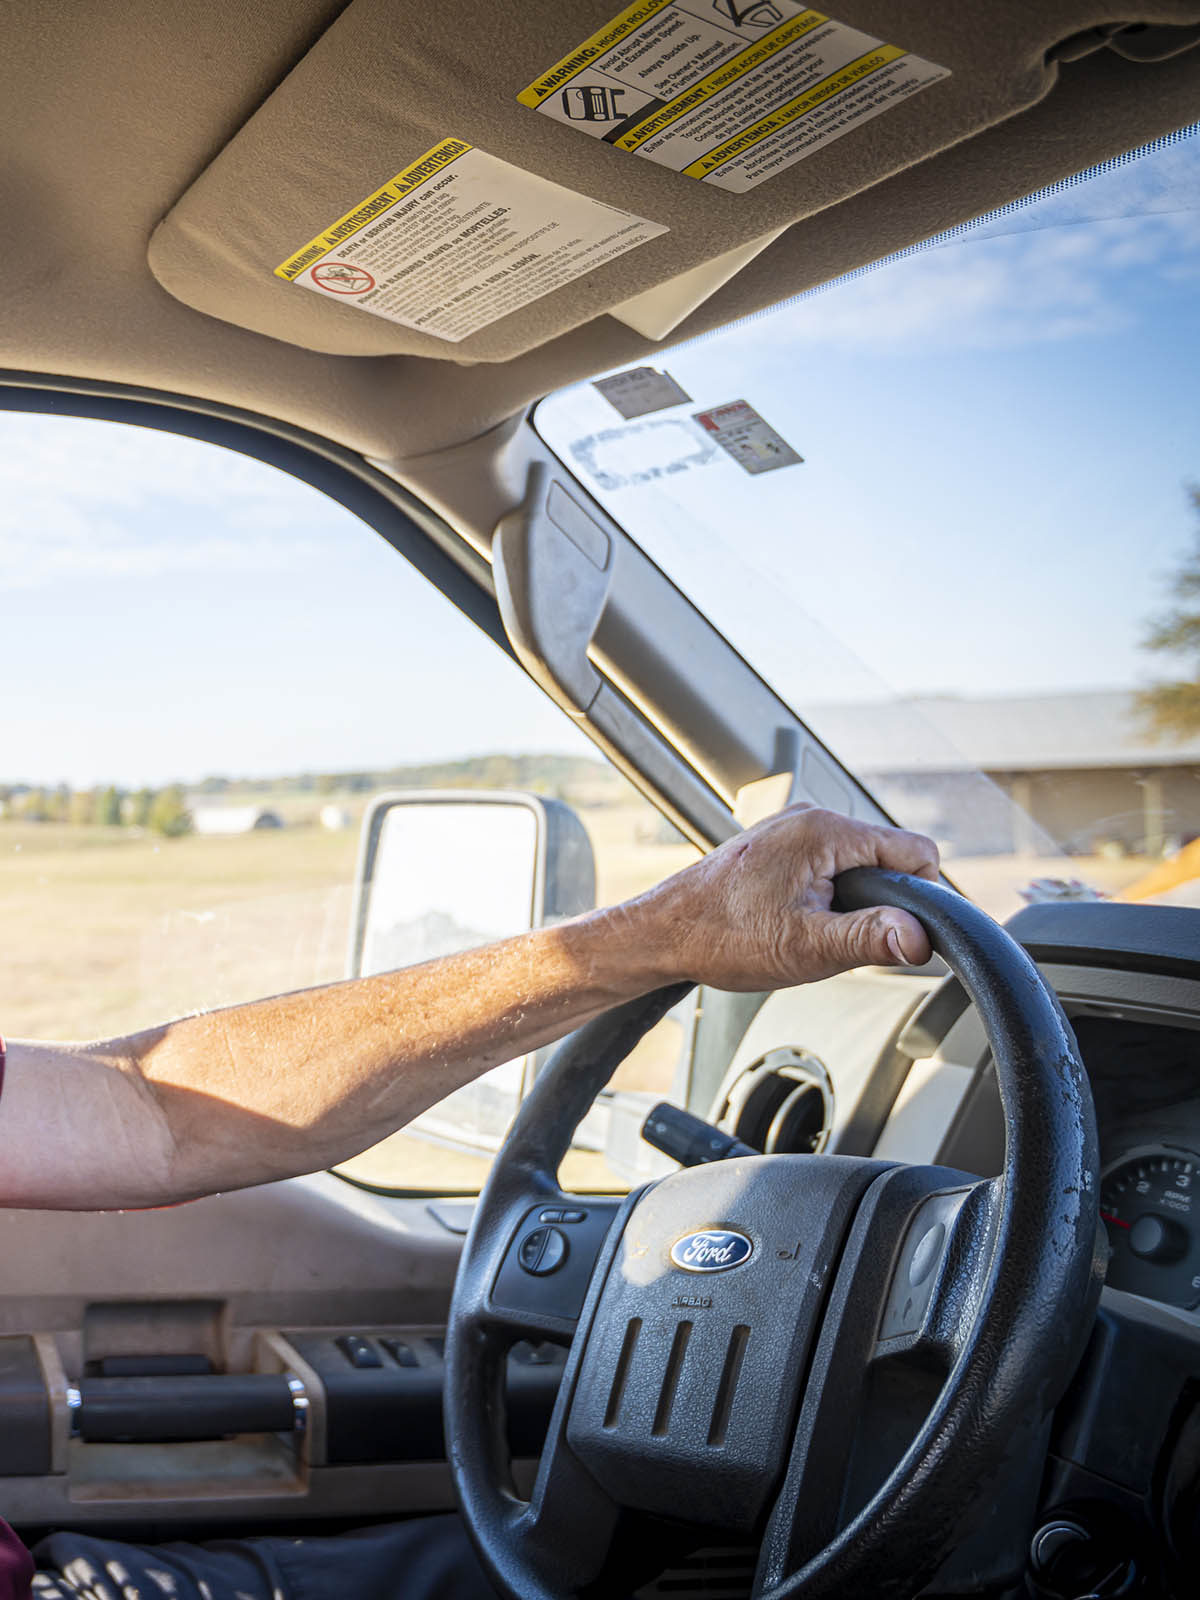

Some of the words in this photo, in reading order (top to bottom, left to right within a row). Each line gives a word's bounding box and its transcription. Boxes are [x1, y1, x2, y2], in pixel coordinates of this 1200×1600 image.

[540, 47, 600, 88] WARNING:
[596, 23, 631, 48] HIGHER
[599, 54, 621, 70] Avoid
[617, 38, 643, 57] Abrupt
[638, 11, 679, 40] Maneuvers
[614, 61, 629, 72] and
[625, 37, 661, 63] Excessive
[657, 20, 685, 38] Speed.
[638, 60, 665, 78] Always
[661, 43, 688, 61] Buckle
[684, 34, 701, 43] Up.
[654, 79, 671, 89] See
[667, 60, 699, 80] Owner's
[694, 40, 724, 60] Manual
[659, 87, 674, 97] For
[671, 70, 699, 89] Further
[696, 42, 742, 71] Information.
[632, 87, 708, 140] AVERTISSEMENT
[711, 66, 742, 86] RISQUE
[739, 49, 767, 68] ACCRU
[763, 42, 778, 51] DE
[775, 16, 818, 43] CAPOTAGE
[643, 139, 665, 153] Éviter
[661, 132, 676, 140] les
[709, 86, 744, 108] brusques
[748, 74, 764, 82] les
[761, 54, 794, 74] vitesses
[694, 121, 728, 142] Consulter
[733, 103, 756, 118] Guide
[763, 70, 807, 98] propriétaire
[805, 58, 825, 72] pour
[680, 120, 712, 139] Toujours
[708, 104, 736, 121] boucler
[744, 79, 774, 99] ceinture
[711, 121, 780, 162] ADVERTENCIA
[782, 100, 812, 118] MAYOR
[808, 82, 840, 102] RIESGO
[837, 75, 853, 84] DE
[724, 123, 741, 134] plus
[714, 166, 734, 177] Evite
[730, 159, 745, 167] las
[743, 138, 780, 160] maniobras
[775, 121, 807, 139] bruscas
[809, 111, 825, 119] las
[745, 169, 764, 180] Para
[762, 156, 785, 170] mayor
[782, 132, 827, 158] información
[846, 102, 876, 120] manual
[779, 132, 809, 149] siempre
[287, 245, 326, 271] WARNING
[330, 191, 396, 239] AVERTISSEMENT
[402, 141, 467, 185] ADVERTENCIA
[337, 242, 361, 258] DEATH
[364, 217, 396, 238] SERIOUS
[392, 199, 420, 219] INJURY
[419, 190, 435, 201] can
[433, 174, 458, 191] occur.
[440, 223, 459, 234] CHILD
[386, 260, 426, 284] BLESSURES
[423, 243, 453, 261] GRAVES
[459, 207, 511, 238] MORTELLES.
[451, 285, 483, 303] MUERTE
[485, 270, 511, 283] SERIA
[506, 253, 541, 271] LESIÓN.
[1136, 1181, 1150, 1193] 2
[1176, 1174, 1190, 1188] 3
[683, 1235, 735, 1263] Ford
[672, 1295, 712, 1307] AIRBAG
